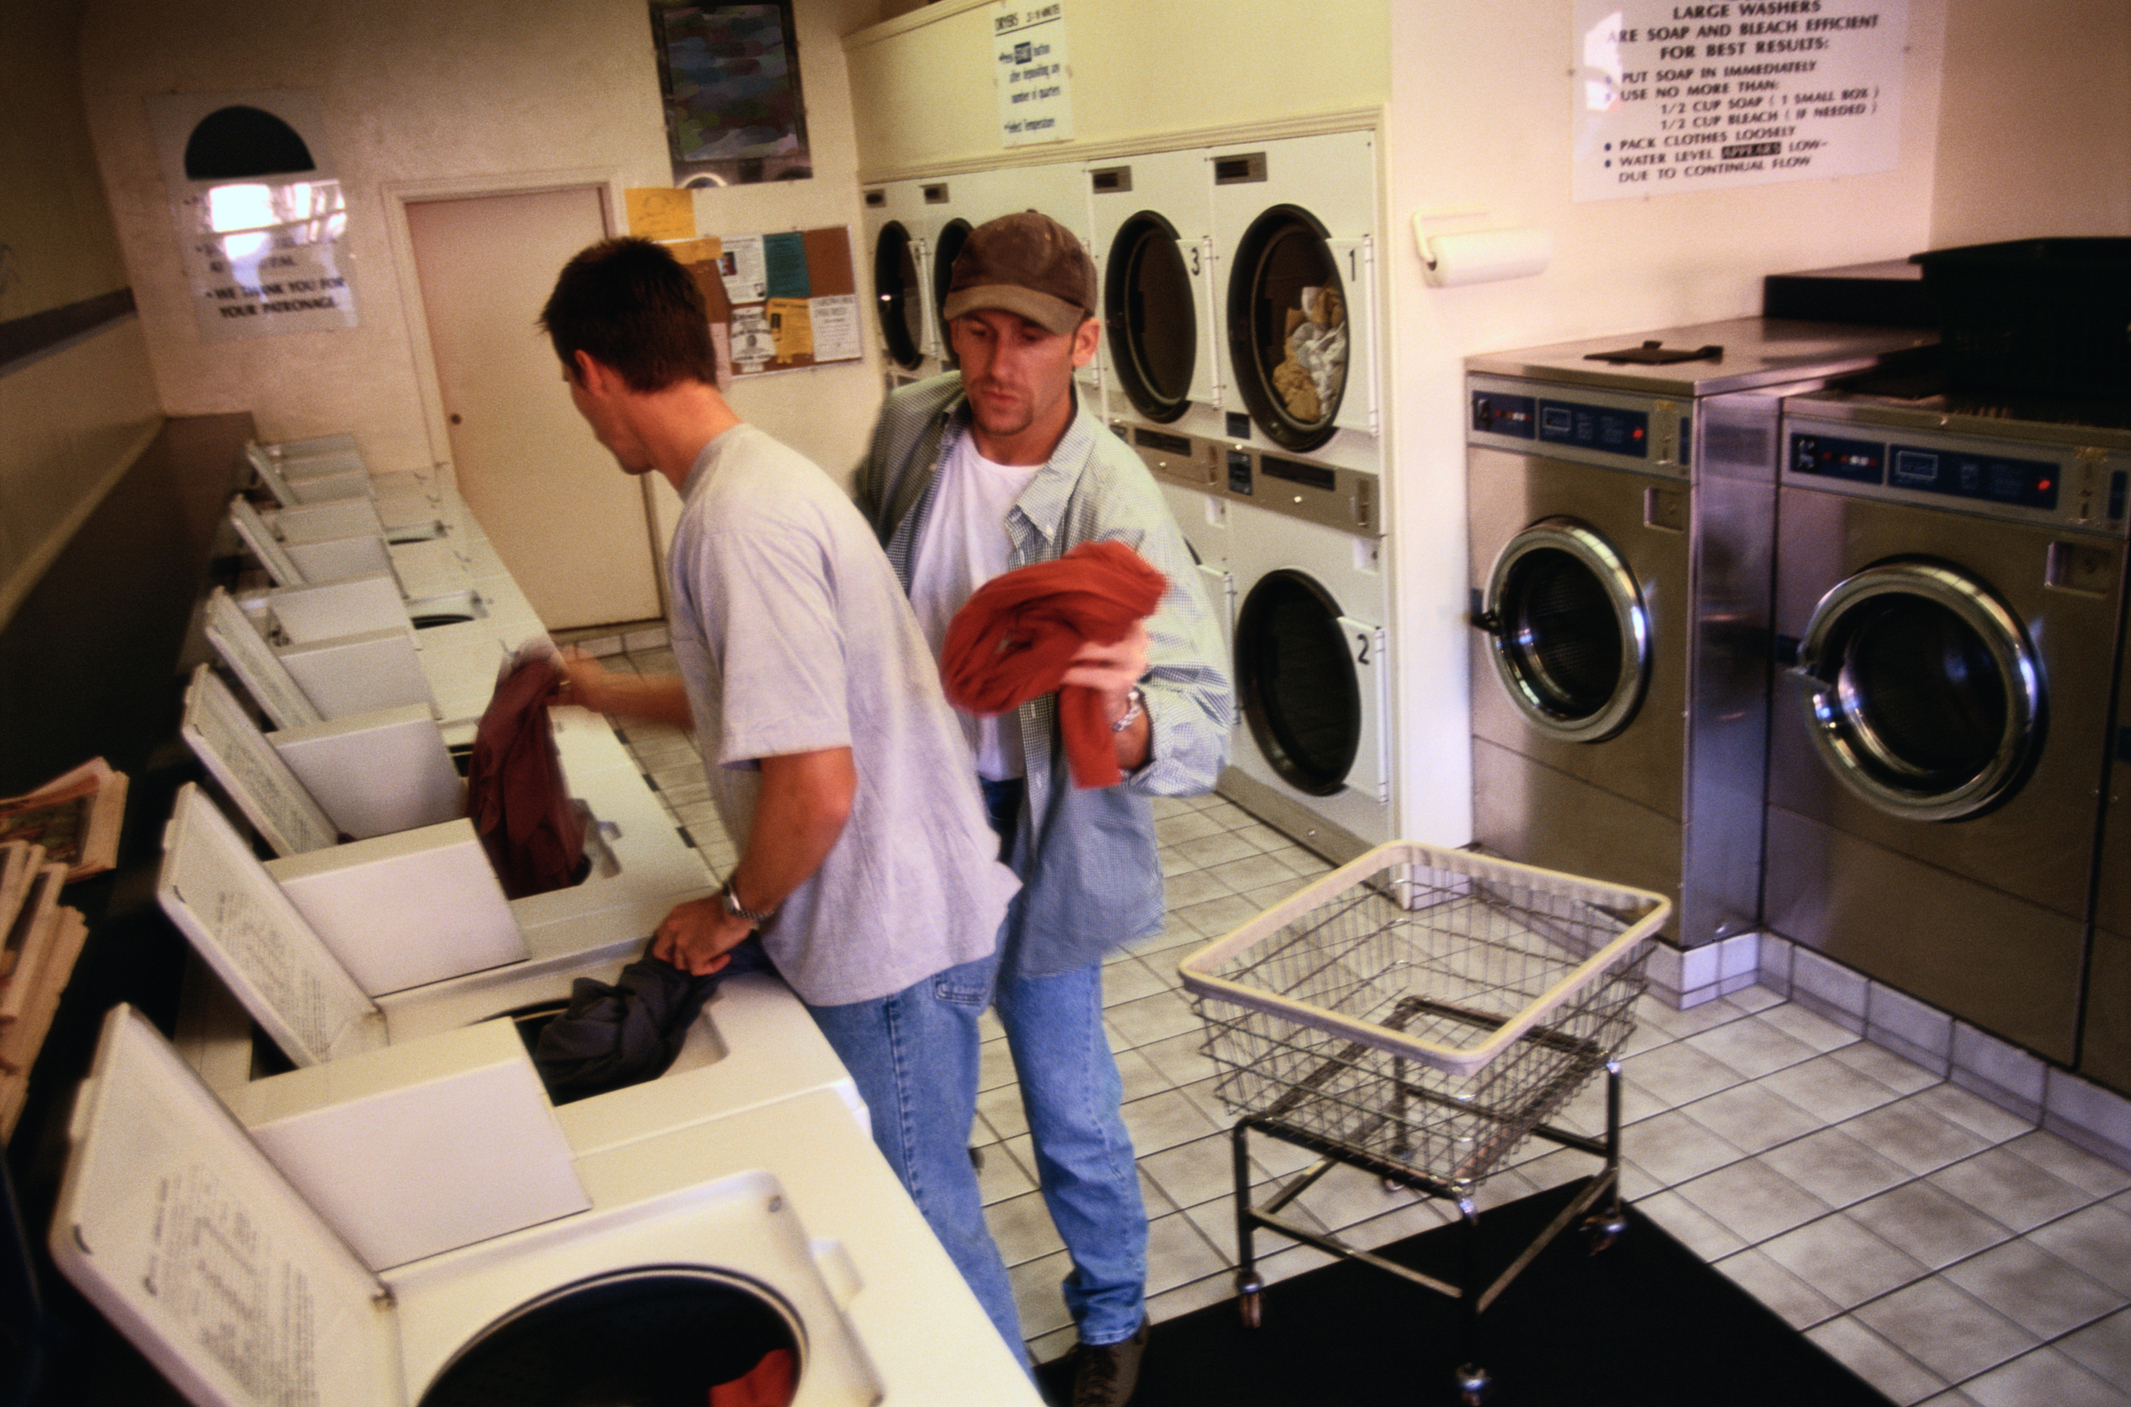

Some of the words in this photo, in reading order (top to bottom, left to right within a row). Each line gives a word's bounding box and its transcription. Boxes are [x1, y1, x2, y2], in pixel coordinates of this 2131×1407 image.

[1673, 4, 1730, 20] LARGE
[1739, 0, 1821, 15] WASHERS
[1647, 26, 1690, 41] SOAP
[1696, 23, 1732, 38] AND
[1740, 20, 1798, 35] BLEACH
[1806, 14, 1879, 31] EFFICIENT
[1660, 45, 1695, 60] FOR
[1706, 42, 1746, 57] BEST
[1756, 37, 1829, 54] RESULTS:
[1622, 71, 1648, 83] PUT
[1656, 68, 1694, 82] SOAP
[1701, 67, 1716, 78] IN
[1724, 61, 1816, 76] IMMEDIATELY
[1621, 88, 1647, 101] USE
[1656, 86, 1680, 98] NO
[1687, 82, 1729, 96] MORE
[1661, 102, 1686, 114] 1/2
[1693, 100, 1721, 112] CUP
[1728, 96, 1763, 110] SOAP
[1795, 91, 1834, 105] SMALL
[1841, 88, 1868, 101] BOX
[1661, 118, 1686, 130] 1/2
[1693, 115, 1721, 127] CUP
[1728, 110, 1778, 125] BLEACH
[1620, 138, 1656, 151] PACK
[1664, 131, 1727, 147] CLOTHES
[1736, 126, 1796, 141] LOOSELY
[1619, 170, 1648, 183] DUE
[1658, 167, 1676, 179] TO
[1684, 161, 1763, 176] CONTINUAL
[1772, 156, 1811, 169] FLOW
[1620, 153, 1666, 167] WATER
[1675, 149, 1714, 162] LEVEL
[1191, 247, 1200, 276] 3
[1349, 249, 1355, 282] 1
[220, 304, 256, 317] YOUR
[263, 297, 334, 312] PATRONAGE
[1357, 633, 1370, 665] 2
